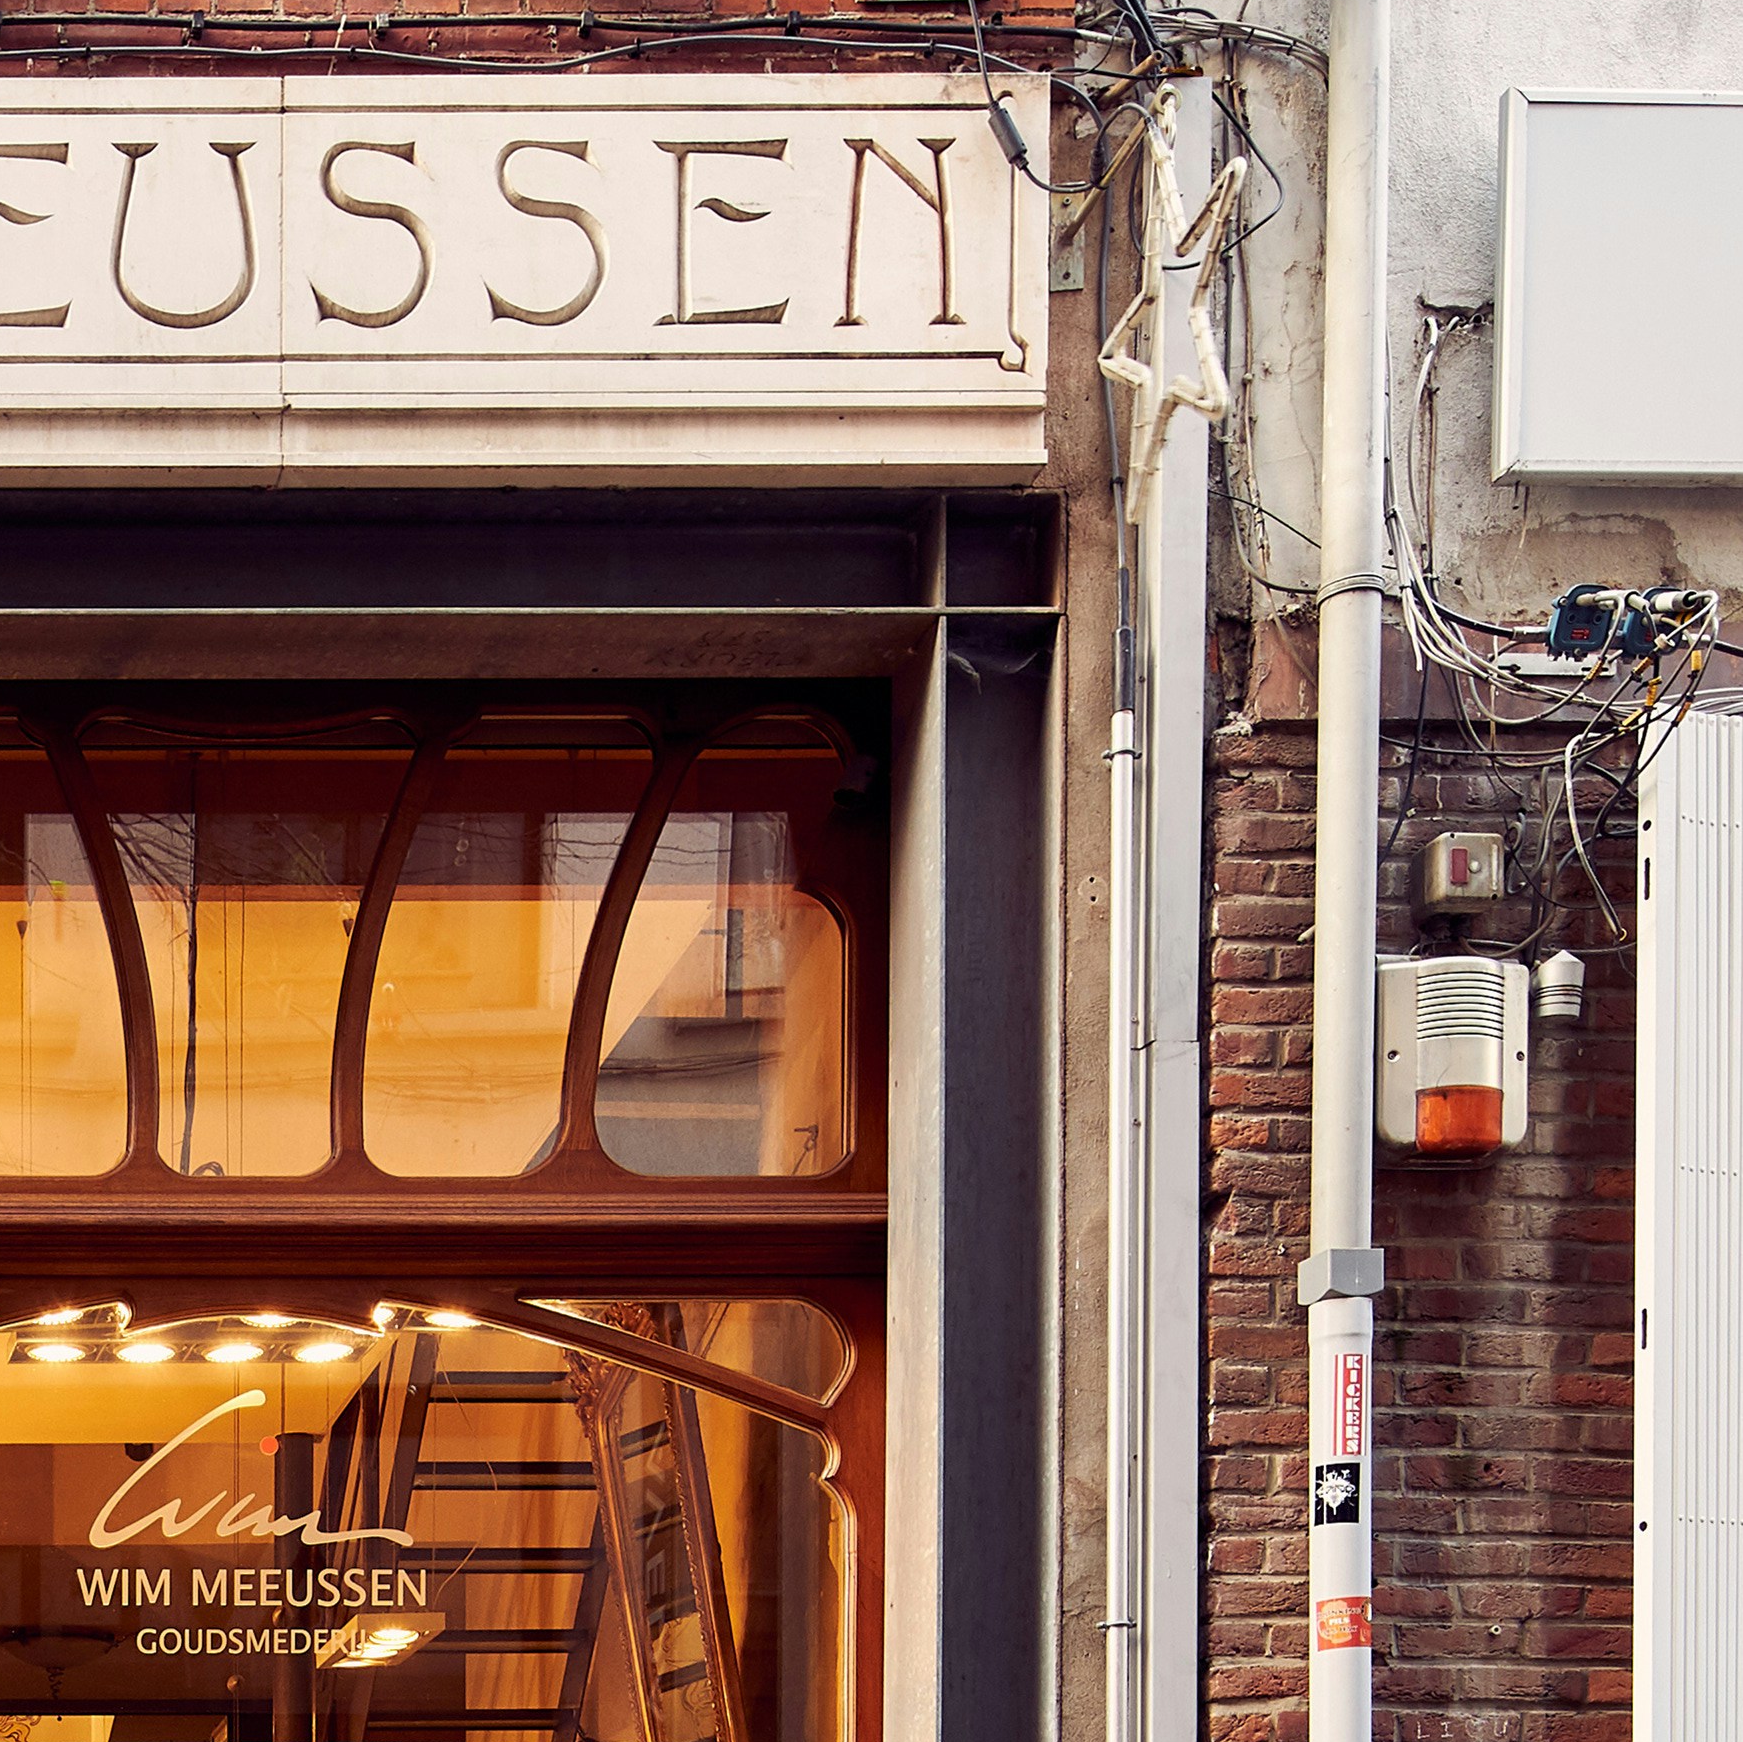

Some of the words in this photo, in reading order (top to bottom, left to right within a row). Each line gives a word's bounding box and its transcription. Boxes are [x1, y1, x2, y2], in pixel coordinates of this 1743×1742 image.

[1345, 1355, 1361, 1453] KICKERS
[76, 1568, 172, 1607] WIM
[191, 1568, 428, 1607] MEEUSSEN
[135, 1627, 368, 1656] GOUDSMEDERIJ
